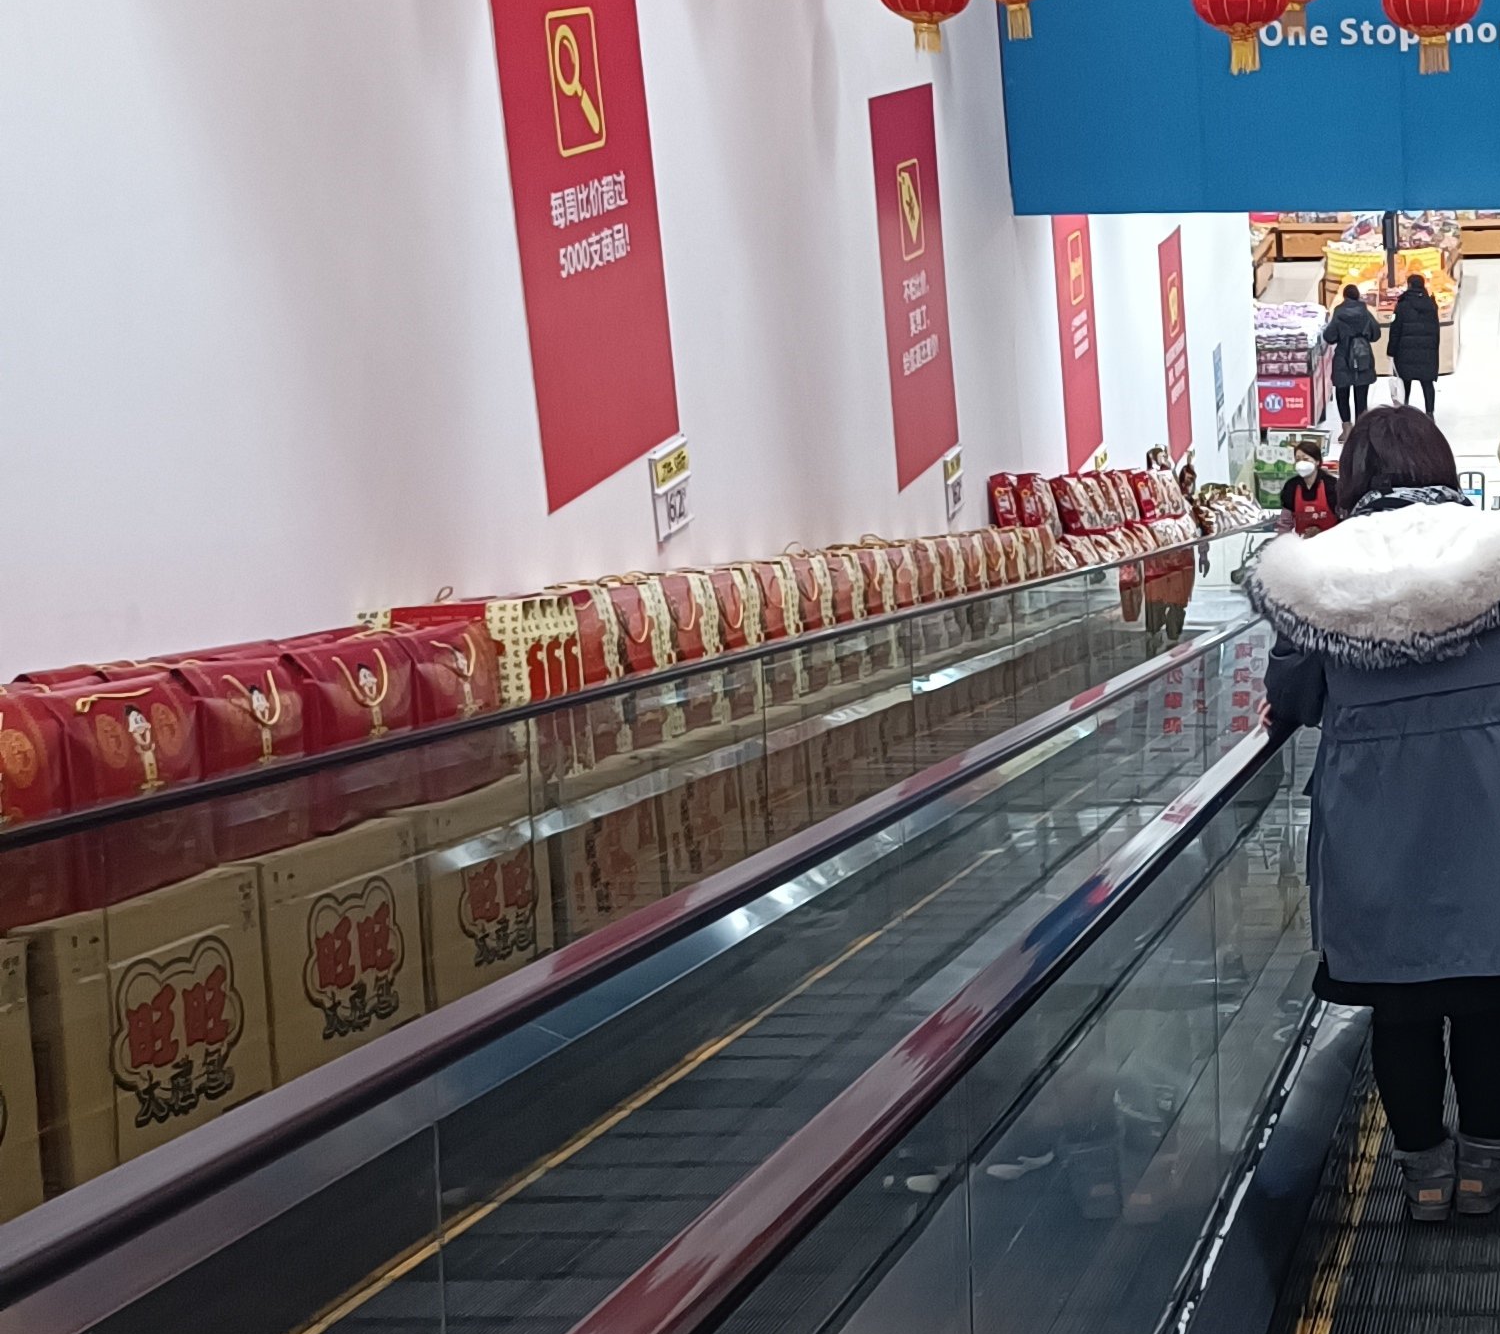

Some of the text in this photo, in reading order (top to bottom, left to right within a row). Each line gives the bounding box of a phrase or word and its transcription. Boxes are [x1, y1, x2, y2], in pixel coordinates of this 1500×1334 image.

[1259, 18, 1329, 47] One
[1340, 18, 1420, 52] Stop
[550, 170, 629, 229] 每周比价超过
[315, 901, 396, 990] 旺旺
[126, 964, 231, 1068] 旺旺
